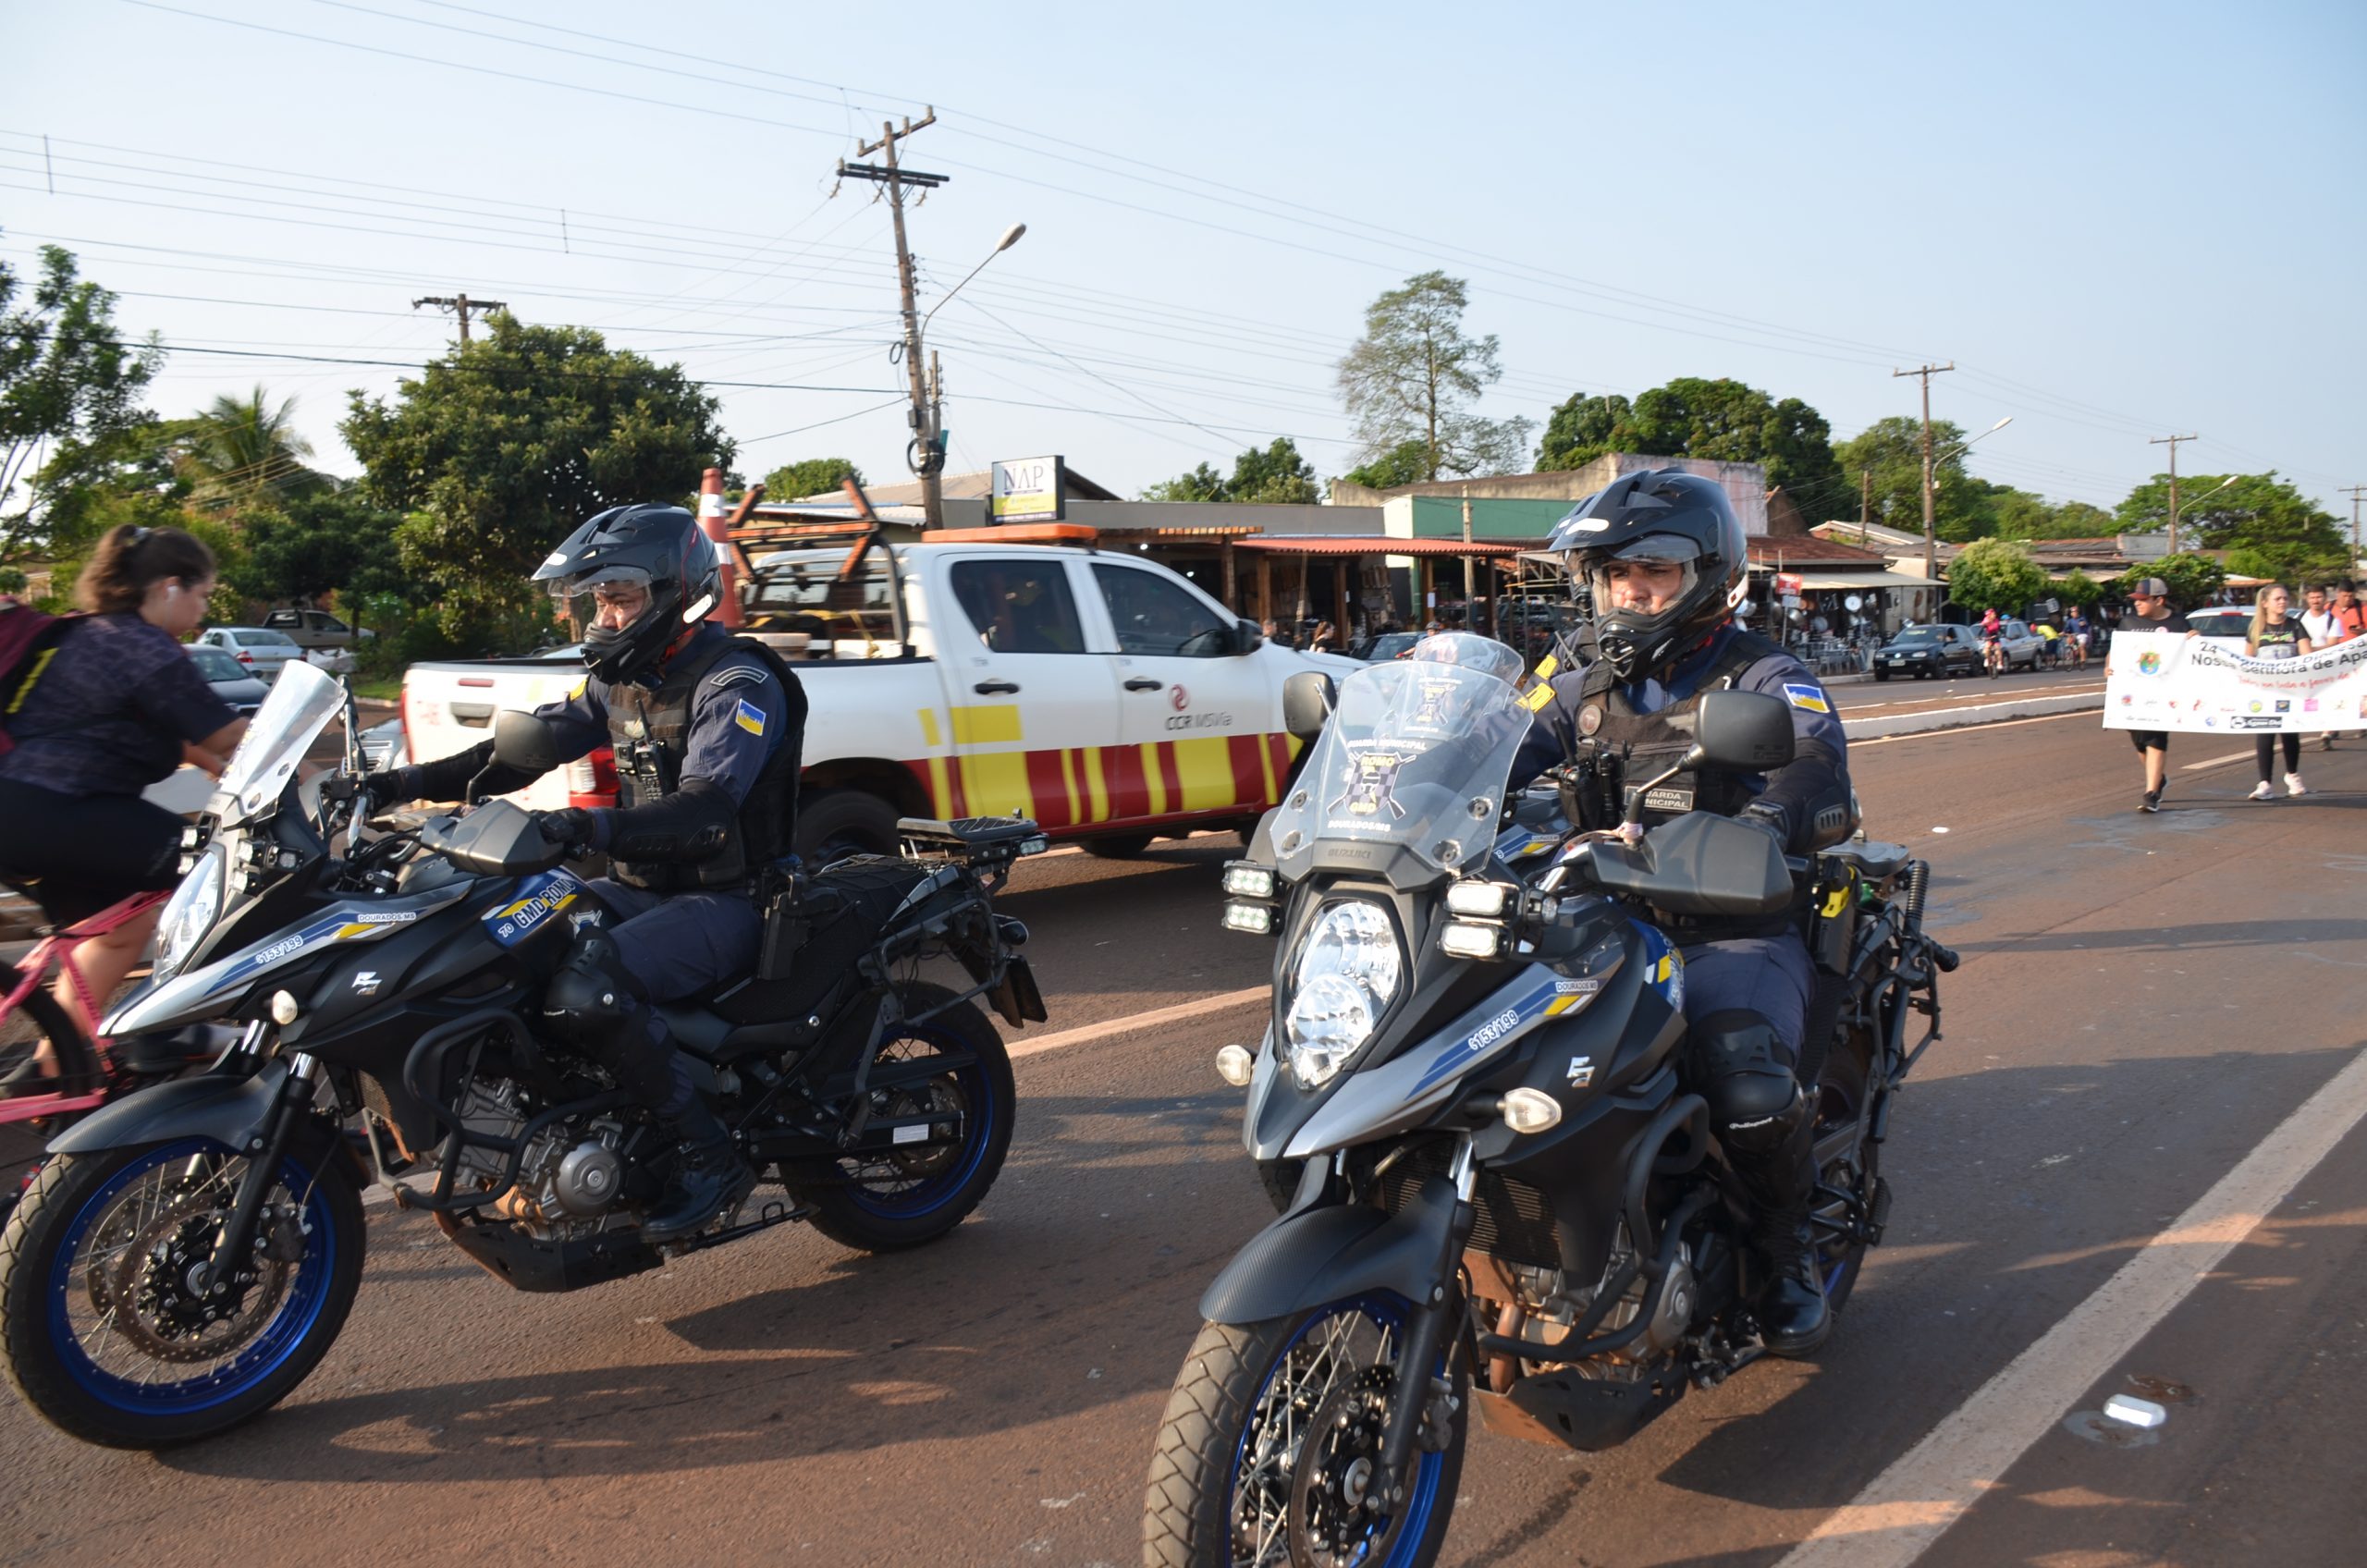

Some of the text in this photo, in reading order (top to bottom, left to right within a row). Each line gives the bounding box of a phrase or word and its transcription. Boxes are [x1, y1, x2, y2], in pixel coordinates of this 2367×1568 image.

[1004, 465, 1044, 490] NAP
[2313, 659, 2334, 670] de
[1646, 791, 1682, 801] UARDA
[1645, 799, 1688, 809] NICIPAL
[497, 923, 514, 937] 70
[512, 897, 547, 928] GMD
